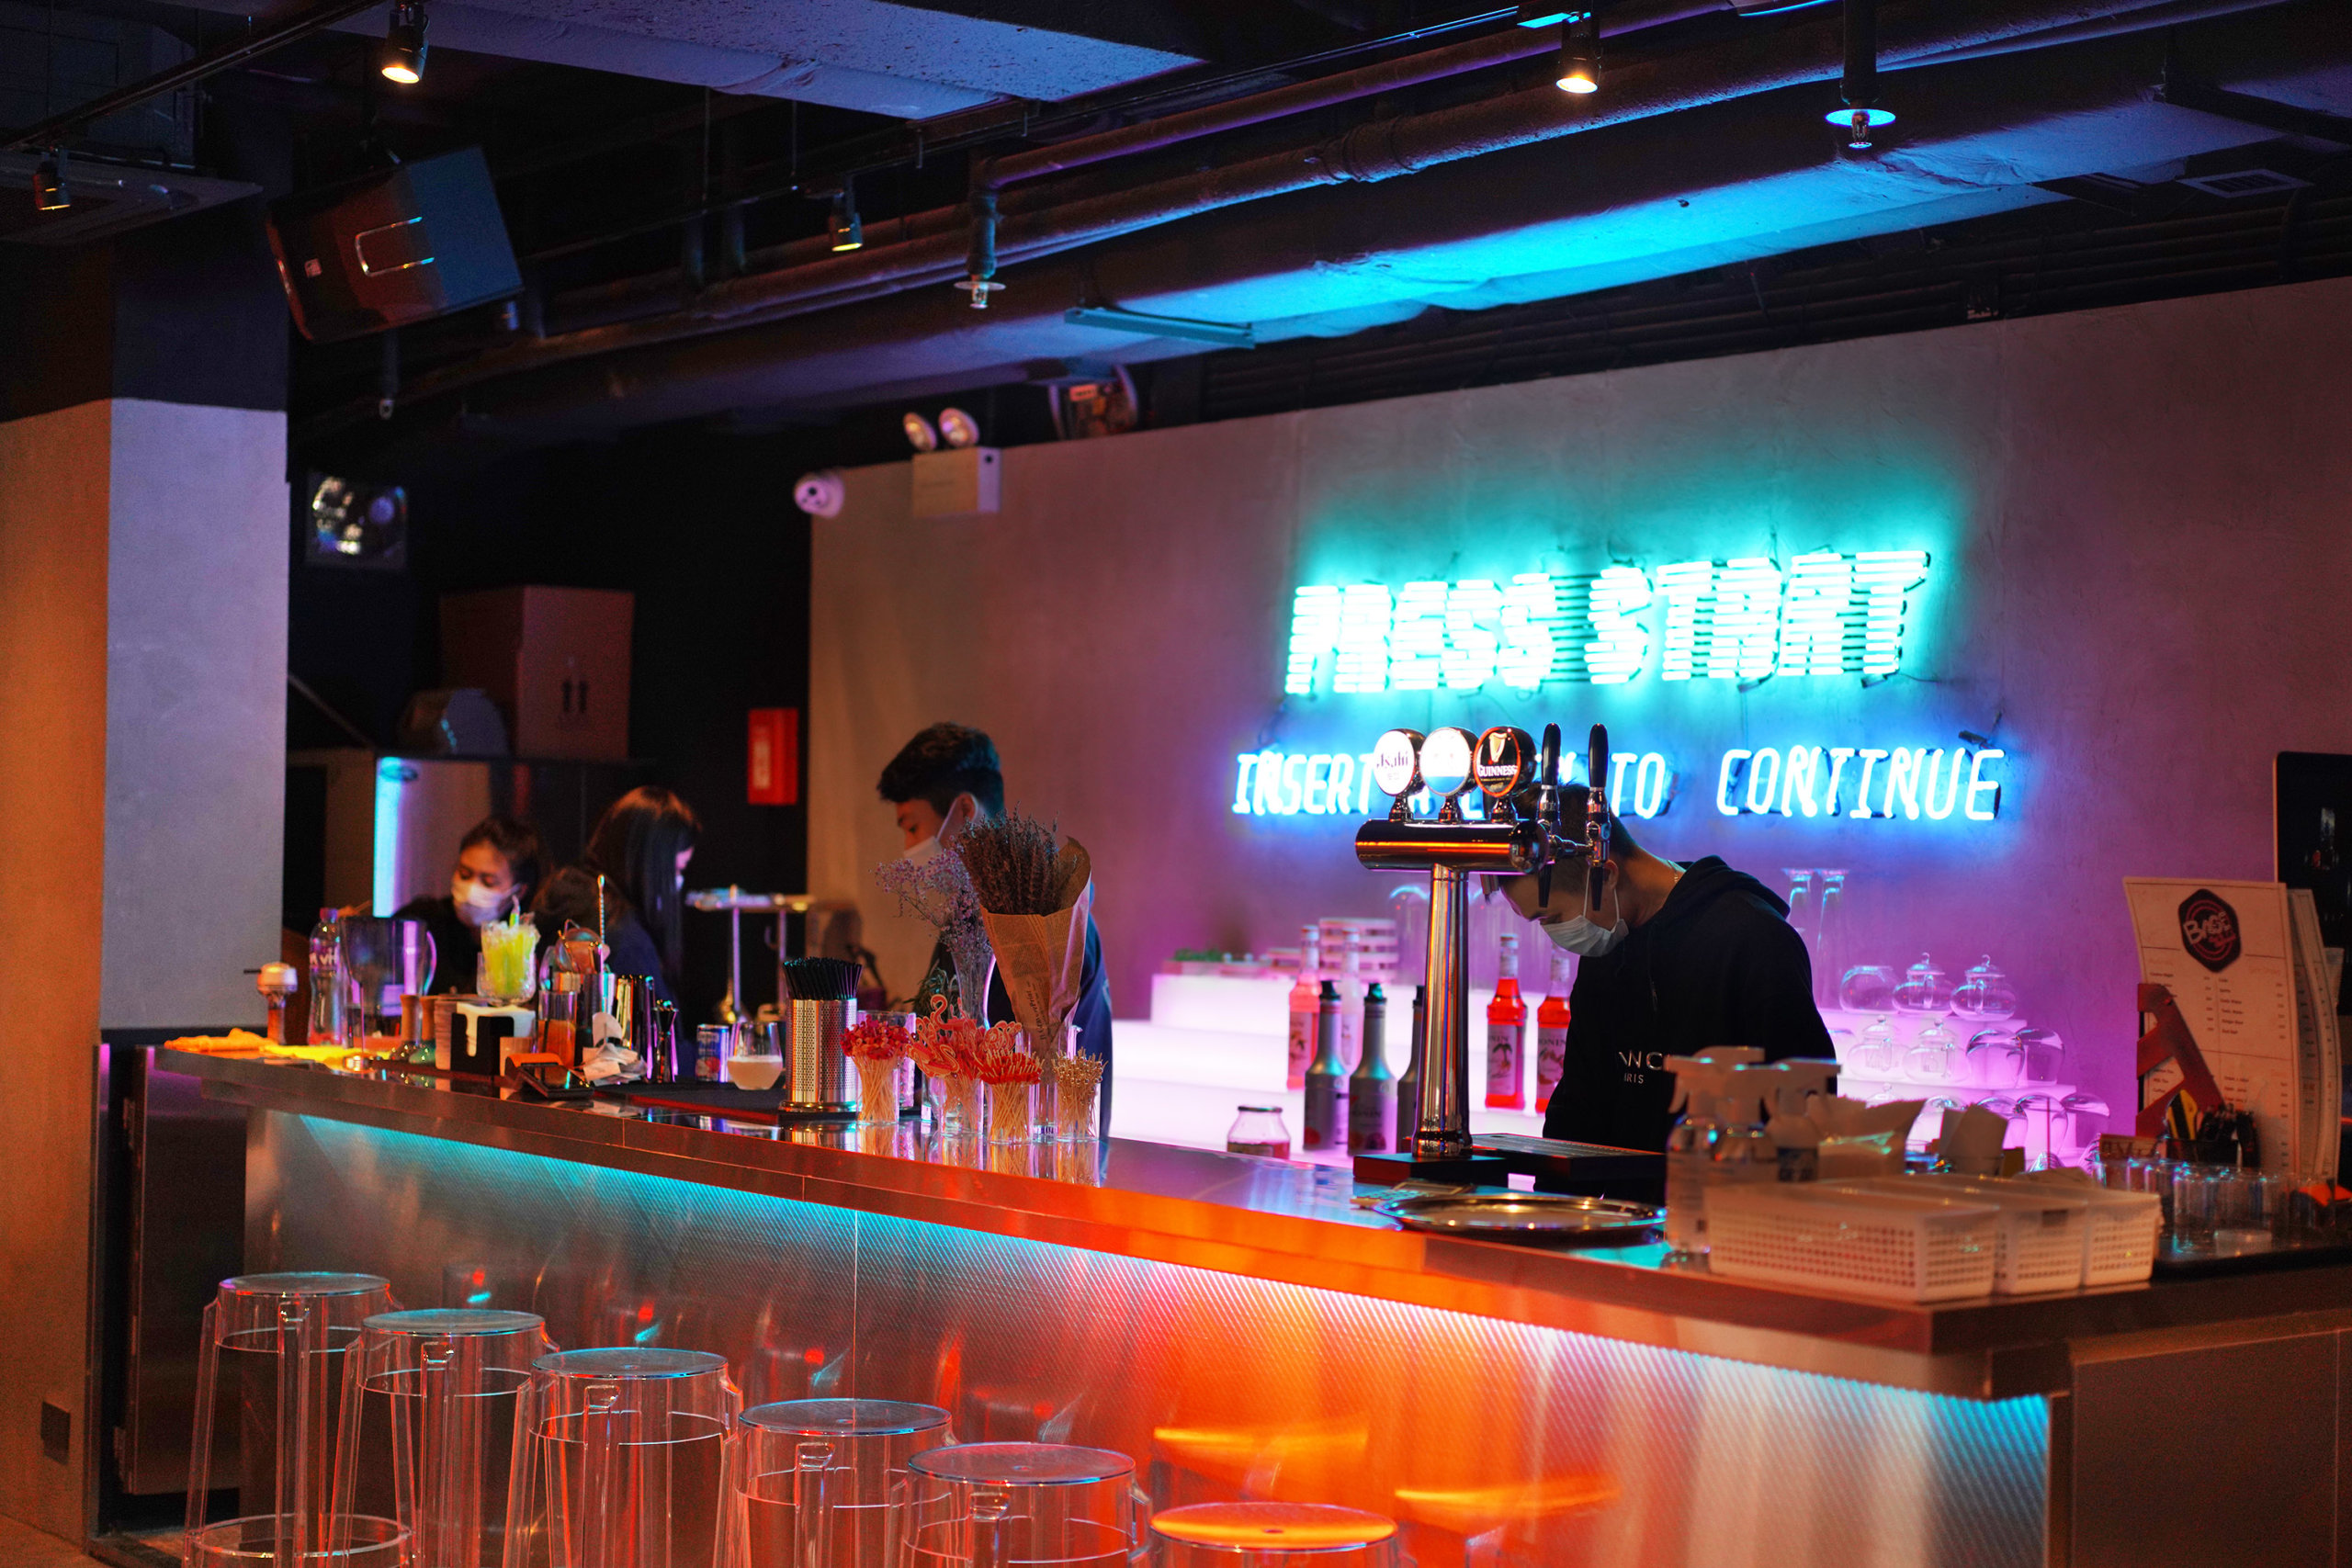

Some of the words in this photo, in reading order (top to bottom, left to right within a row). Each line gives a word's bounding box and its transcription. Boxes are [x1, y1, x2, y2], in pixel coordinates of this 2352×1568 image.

[1284, 571, 1558, 695] PRESS
[1584, 550, 1928, 685] START
[1376, 750, 1409, 769] Asahi
[1476, 764, 1519, 777] GUINNESS
[1231, 750, 1376, 817] INSERT
[1611, 751, 1665, 819] TO
[1716, 746, 2006, 822] CONTINUE
